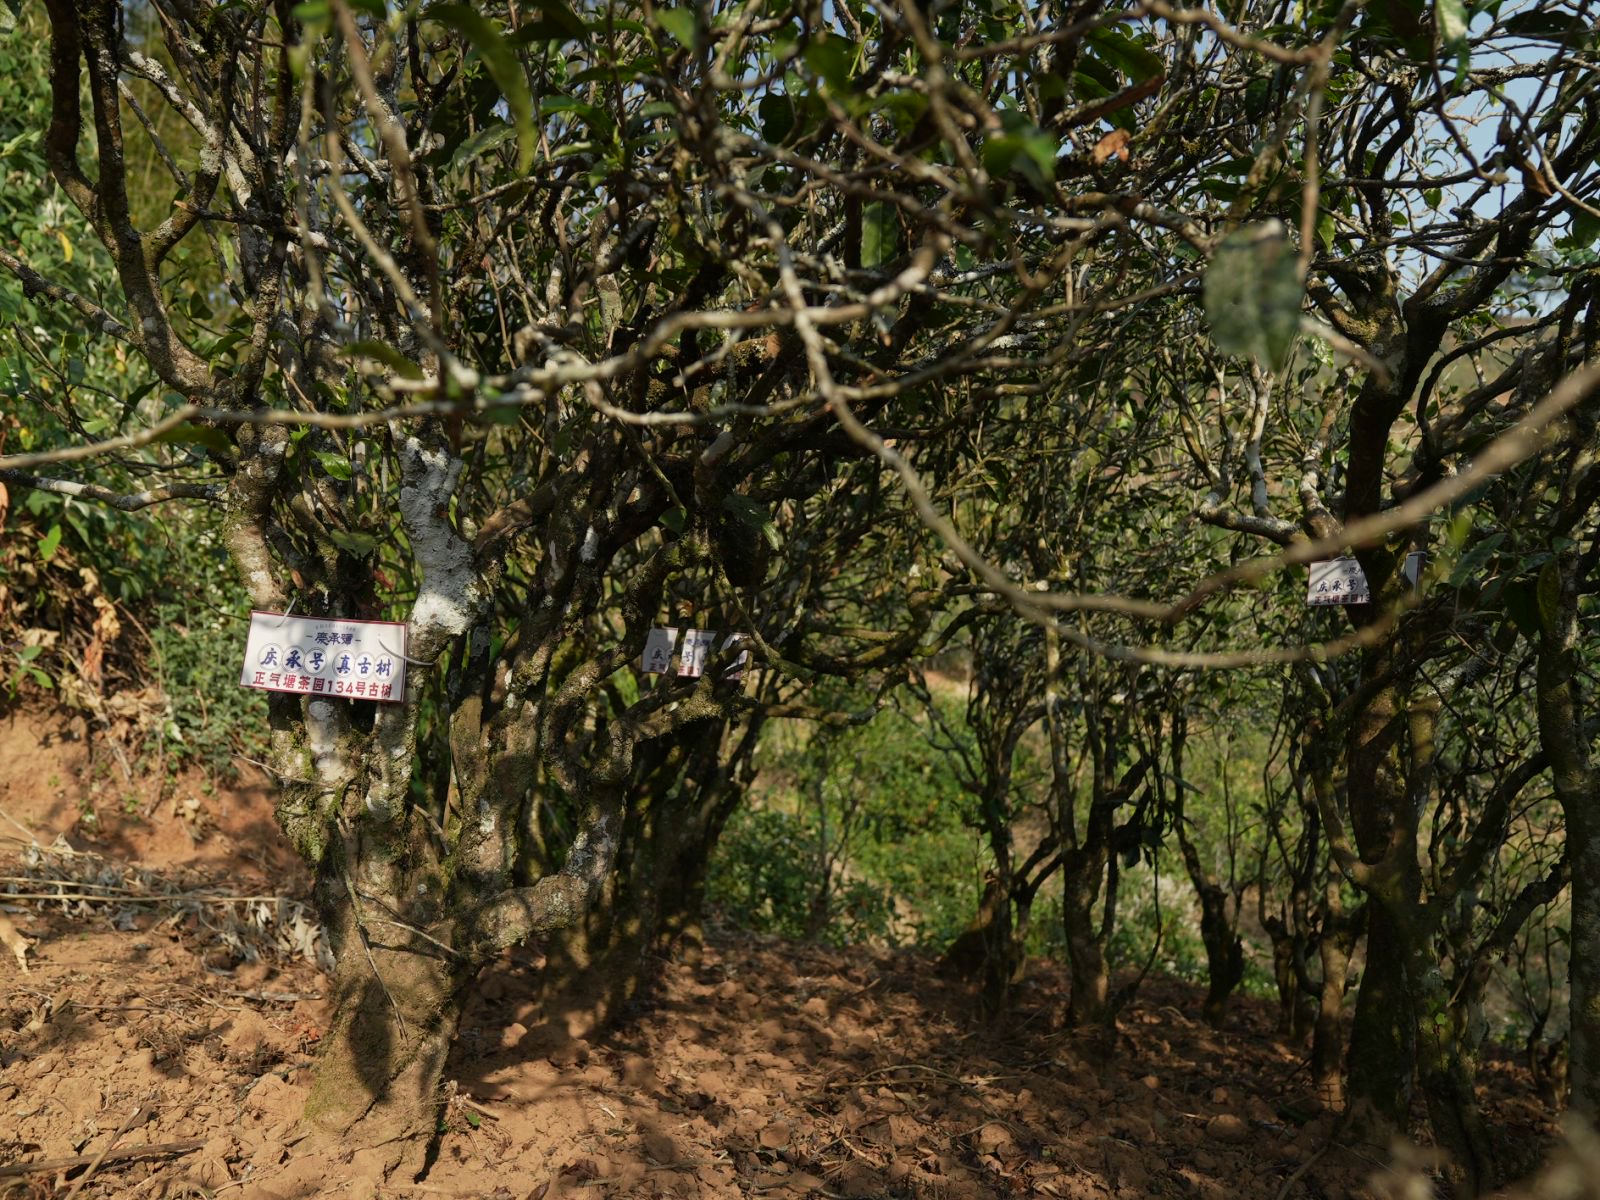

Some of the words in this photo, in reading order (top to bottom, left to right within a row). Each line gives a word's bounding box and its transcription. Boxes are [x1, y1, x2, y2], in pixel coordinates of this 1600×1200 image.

[260, 648, 324, 670] 庆承号
[336, 655, 392, 677] 真古树
[252, 671, 393, 698] 正气塘茶园134号古树
